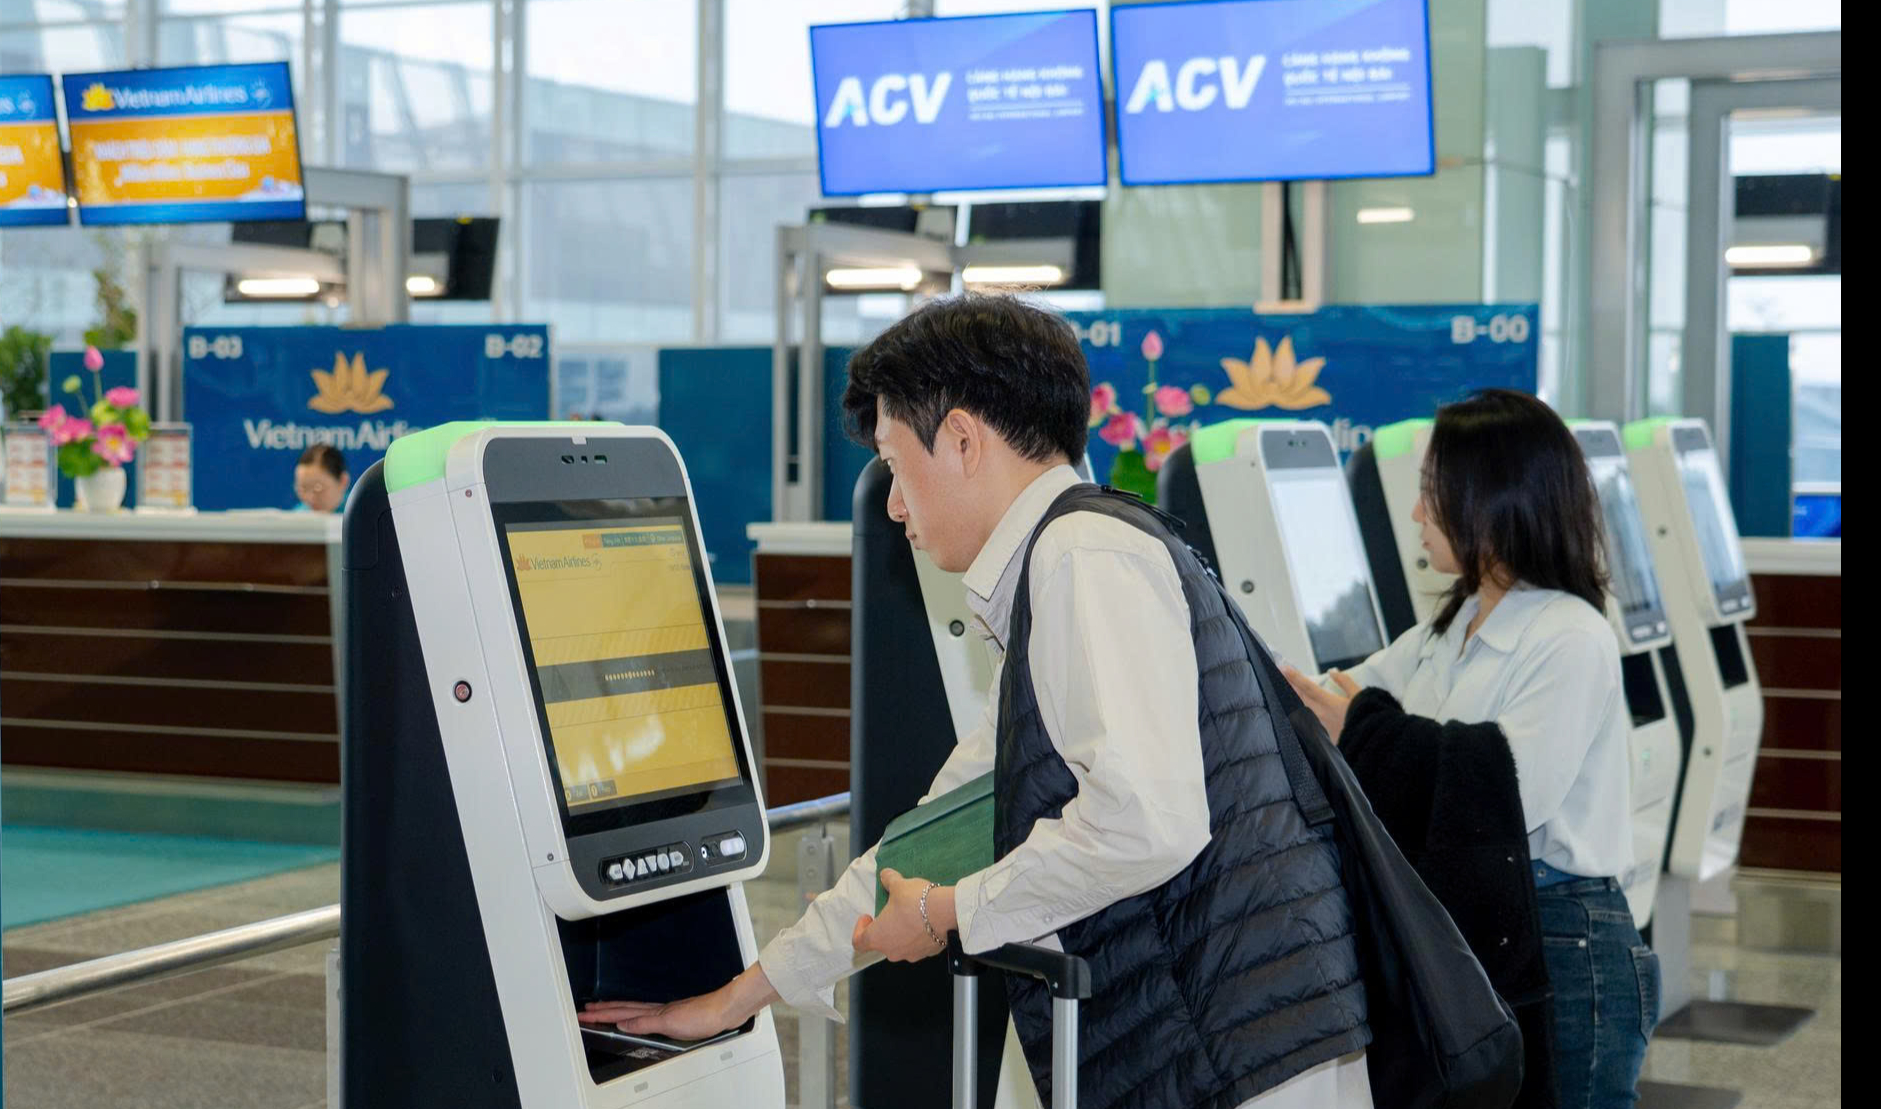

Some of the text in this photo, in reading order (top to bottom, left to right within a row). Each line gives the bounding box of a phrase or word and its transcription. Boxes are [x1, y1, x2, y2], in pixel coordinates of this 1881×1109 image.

[1126, 54, 1266, 114] ACV
[825, 72, 952, 128] ACV
[1452, 315, 1529, 344] B-00
[189, 337, 243, 359] B-03
[485, 335, 543, 358] B-02
